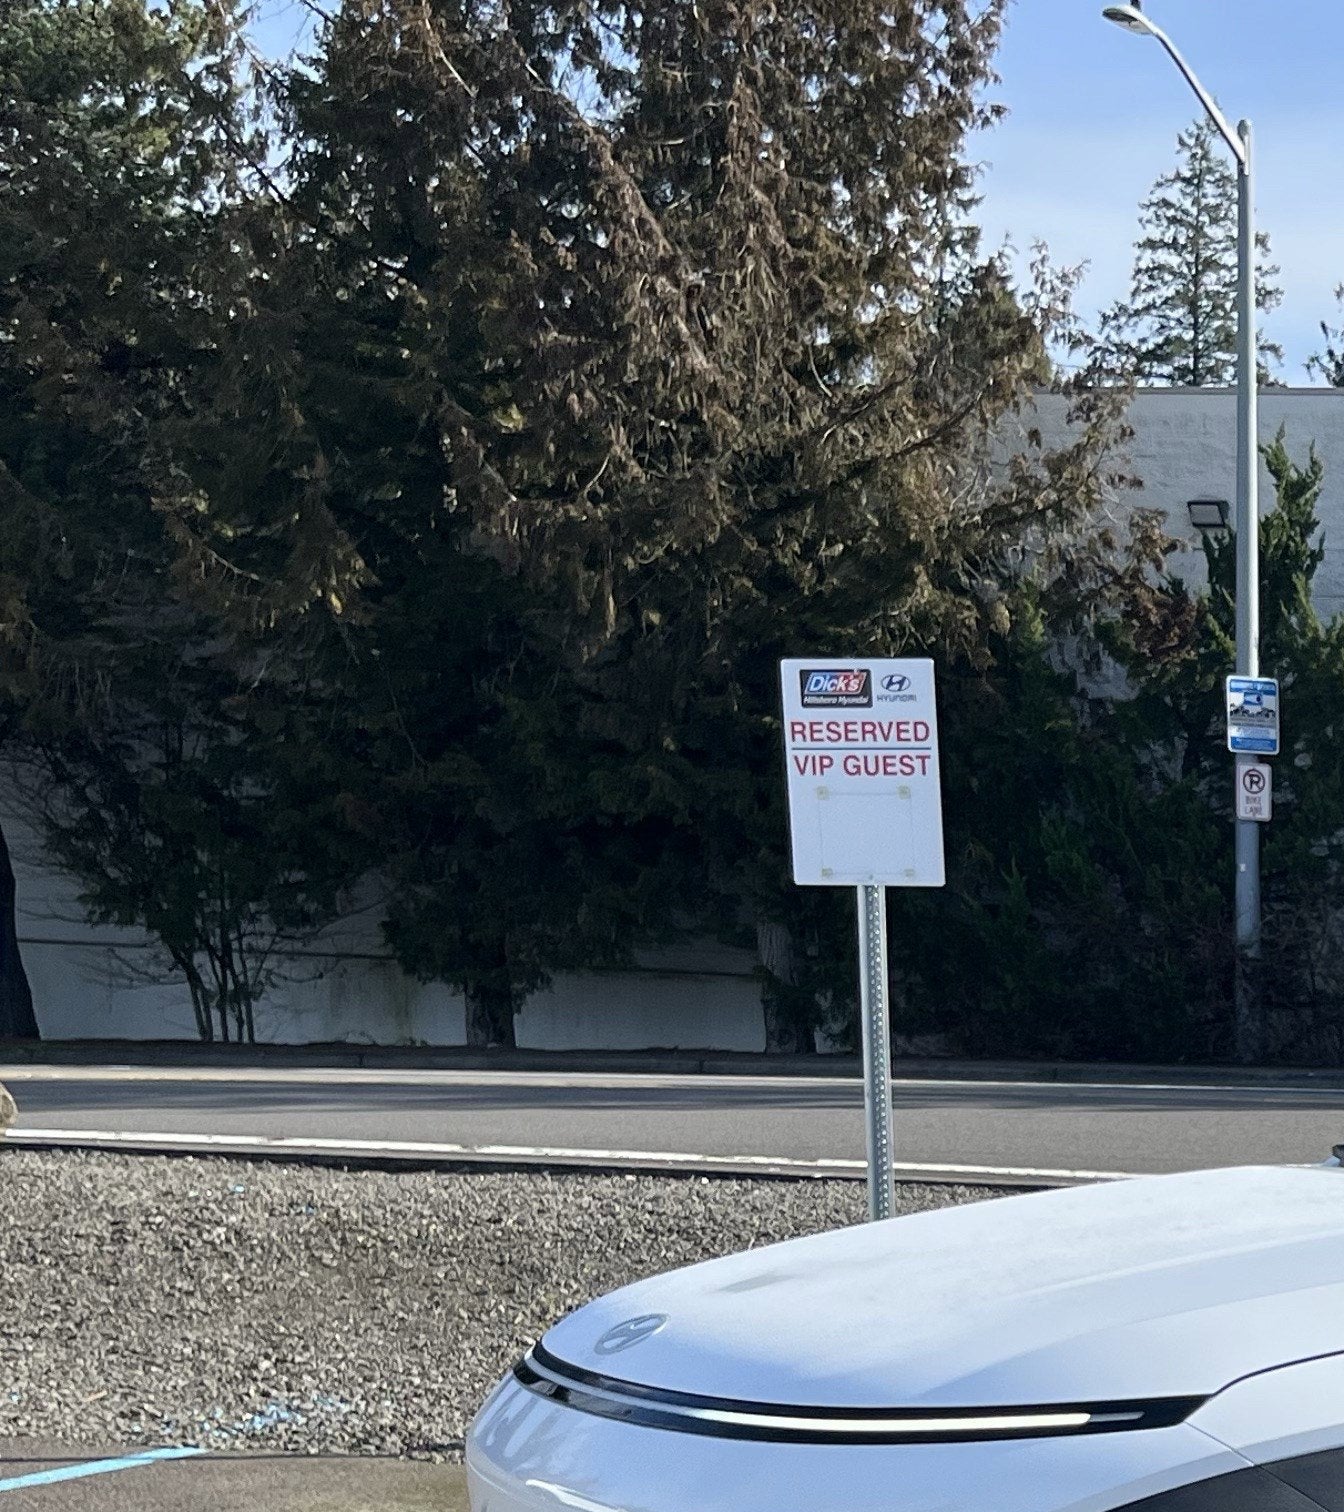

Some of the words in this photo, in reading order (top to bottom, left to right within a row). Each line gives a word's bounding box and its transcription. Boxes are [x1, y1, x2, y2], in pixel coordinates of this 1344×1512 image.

[790, 721, 930, 743] RESERVED
[794, 755, 834, 776] VIP
[843, 755, 932, 776] GUEST
